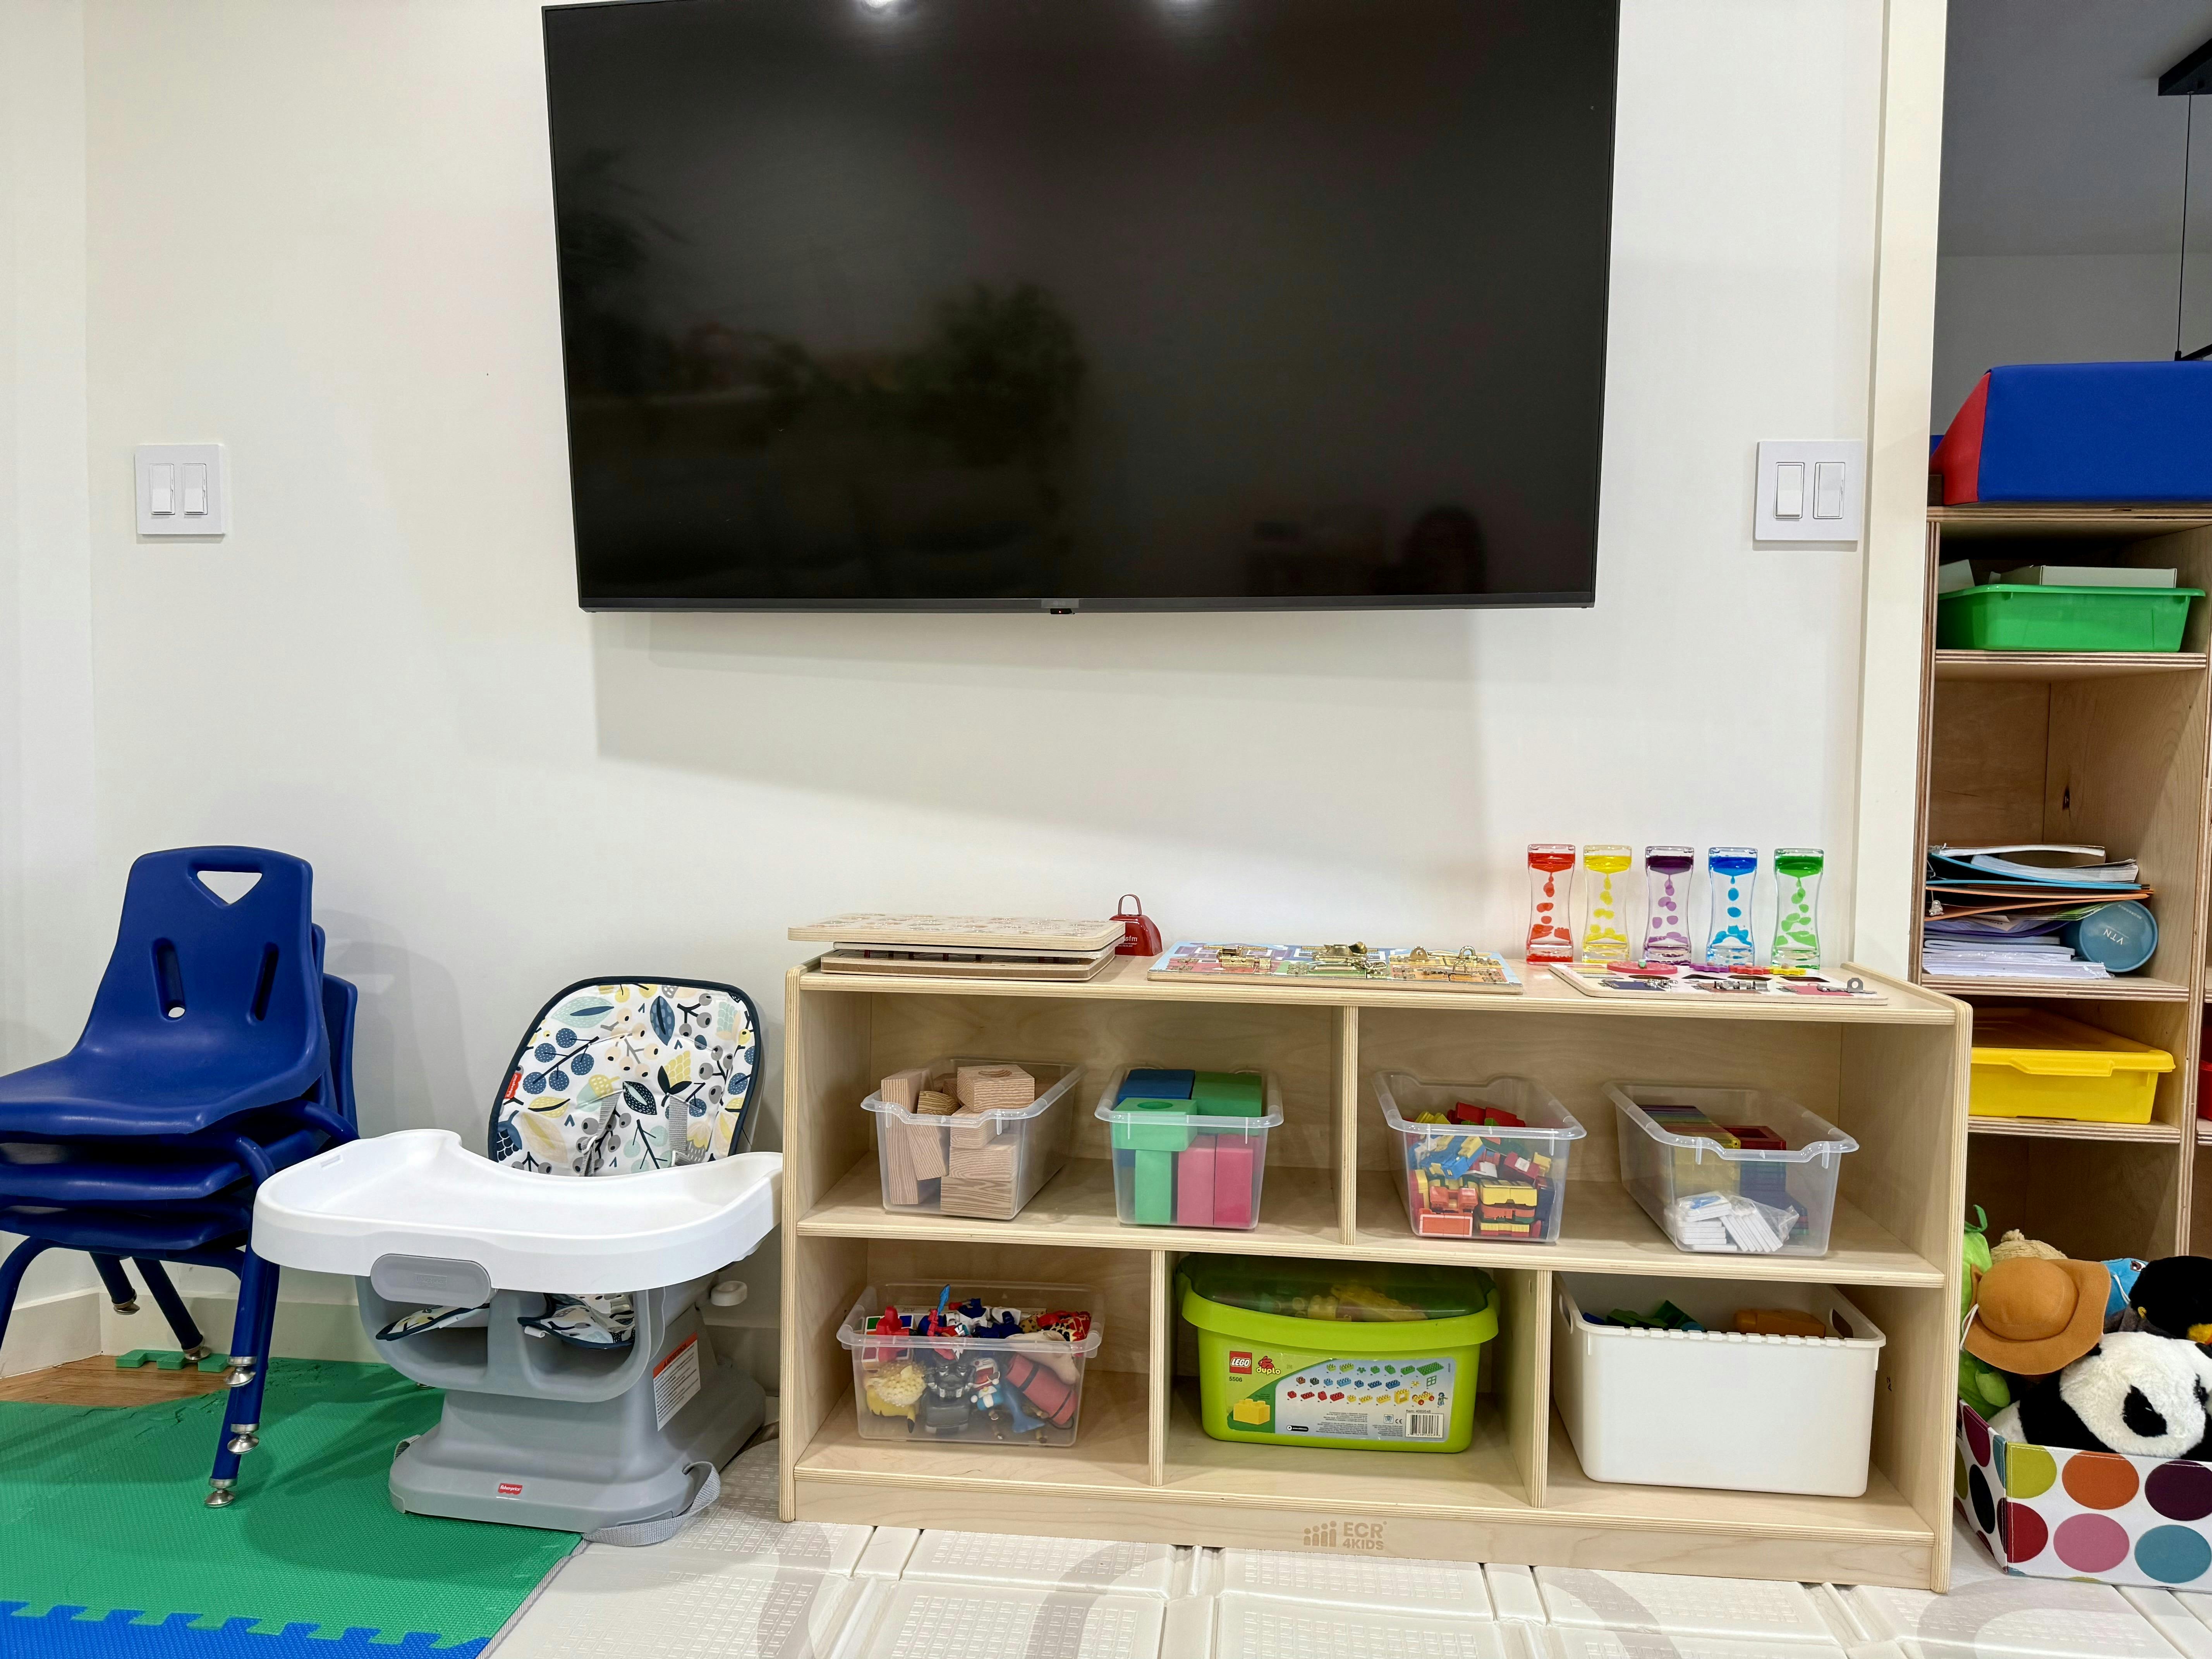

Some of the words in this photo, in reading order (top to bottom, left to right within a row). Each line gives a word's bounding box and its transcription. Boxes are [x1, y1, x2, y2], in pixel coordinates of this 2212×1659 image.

[1231, 1358, 1250, 1367] LEGO
[1256, 1366, 1281, 1375] duplo
[1343, 1522, 1383, 1539] ECR
[1342, 1538, 1384, 1550] 4KIDS
